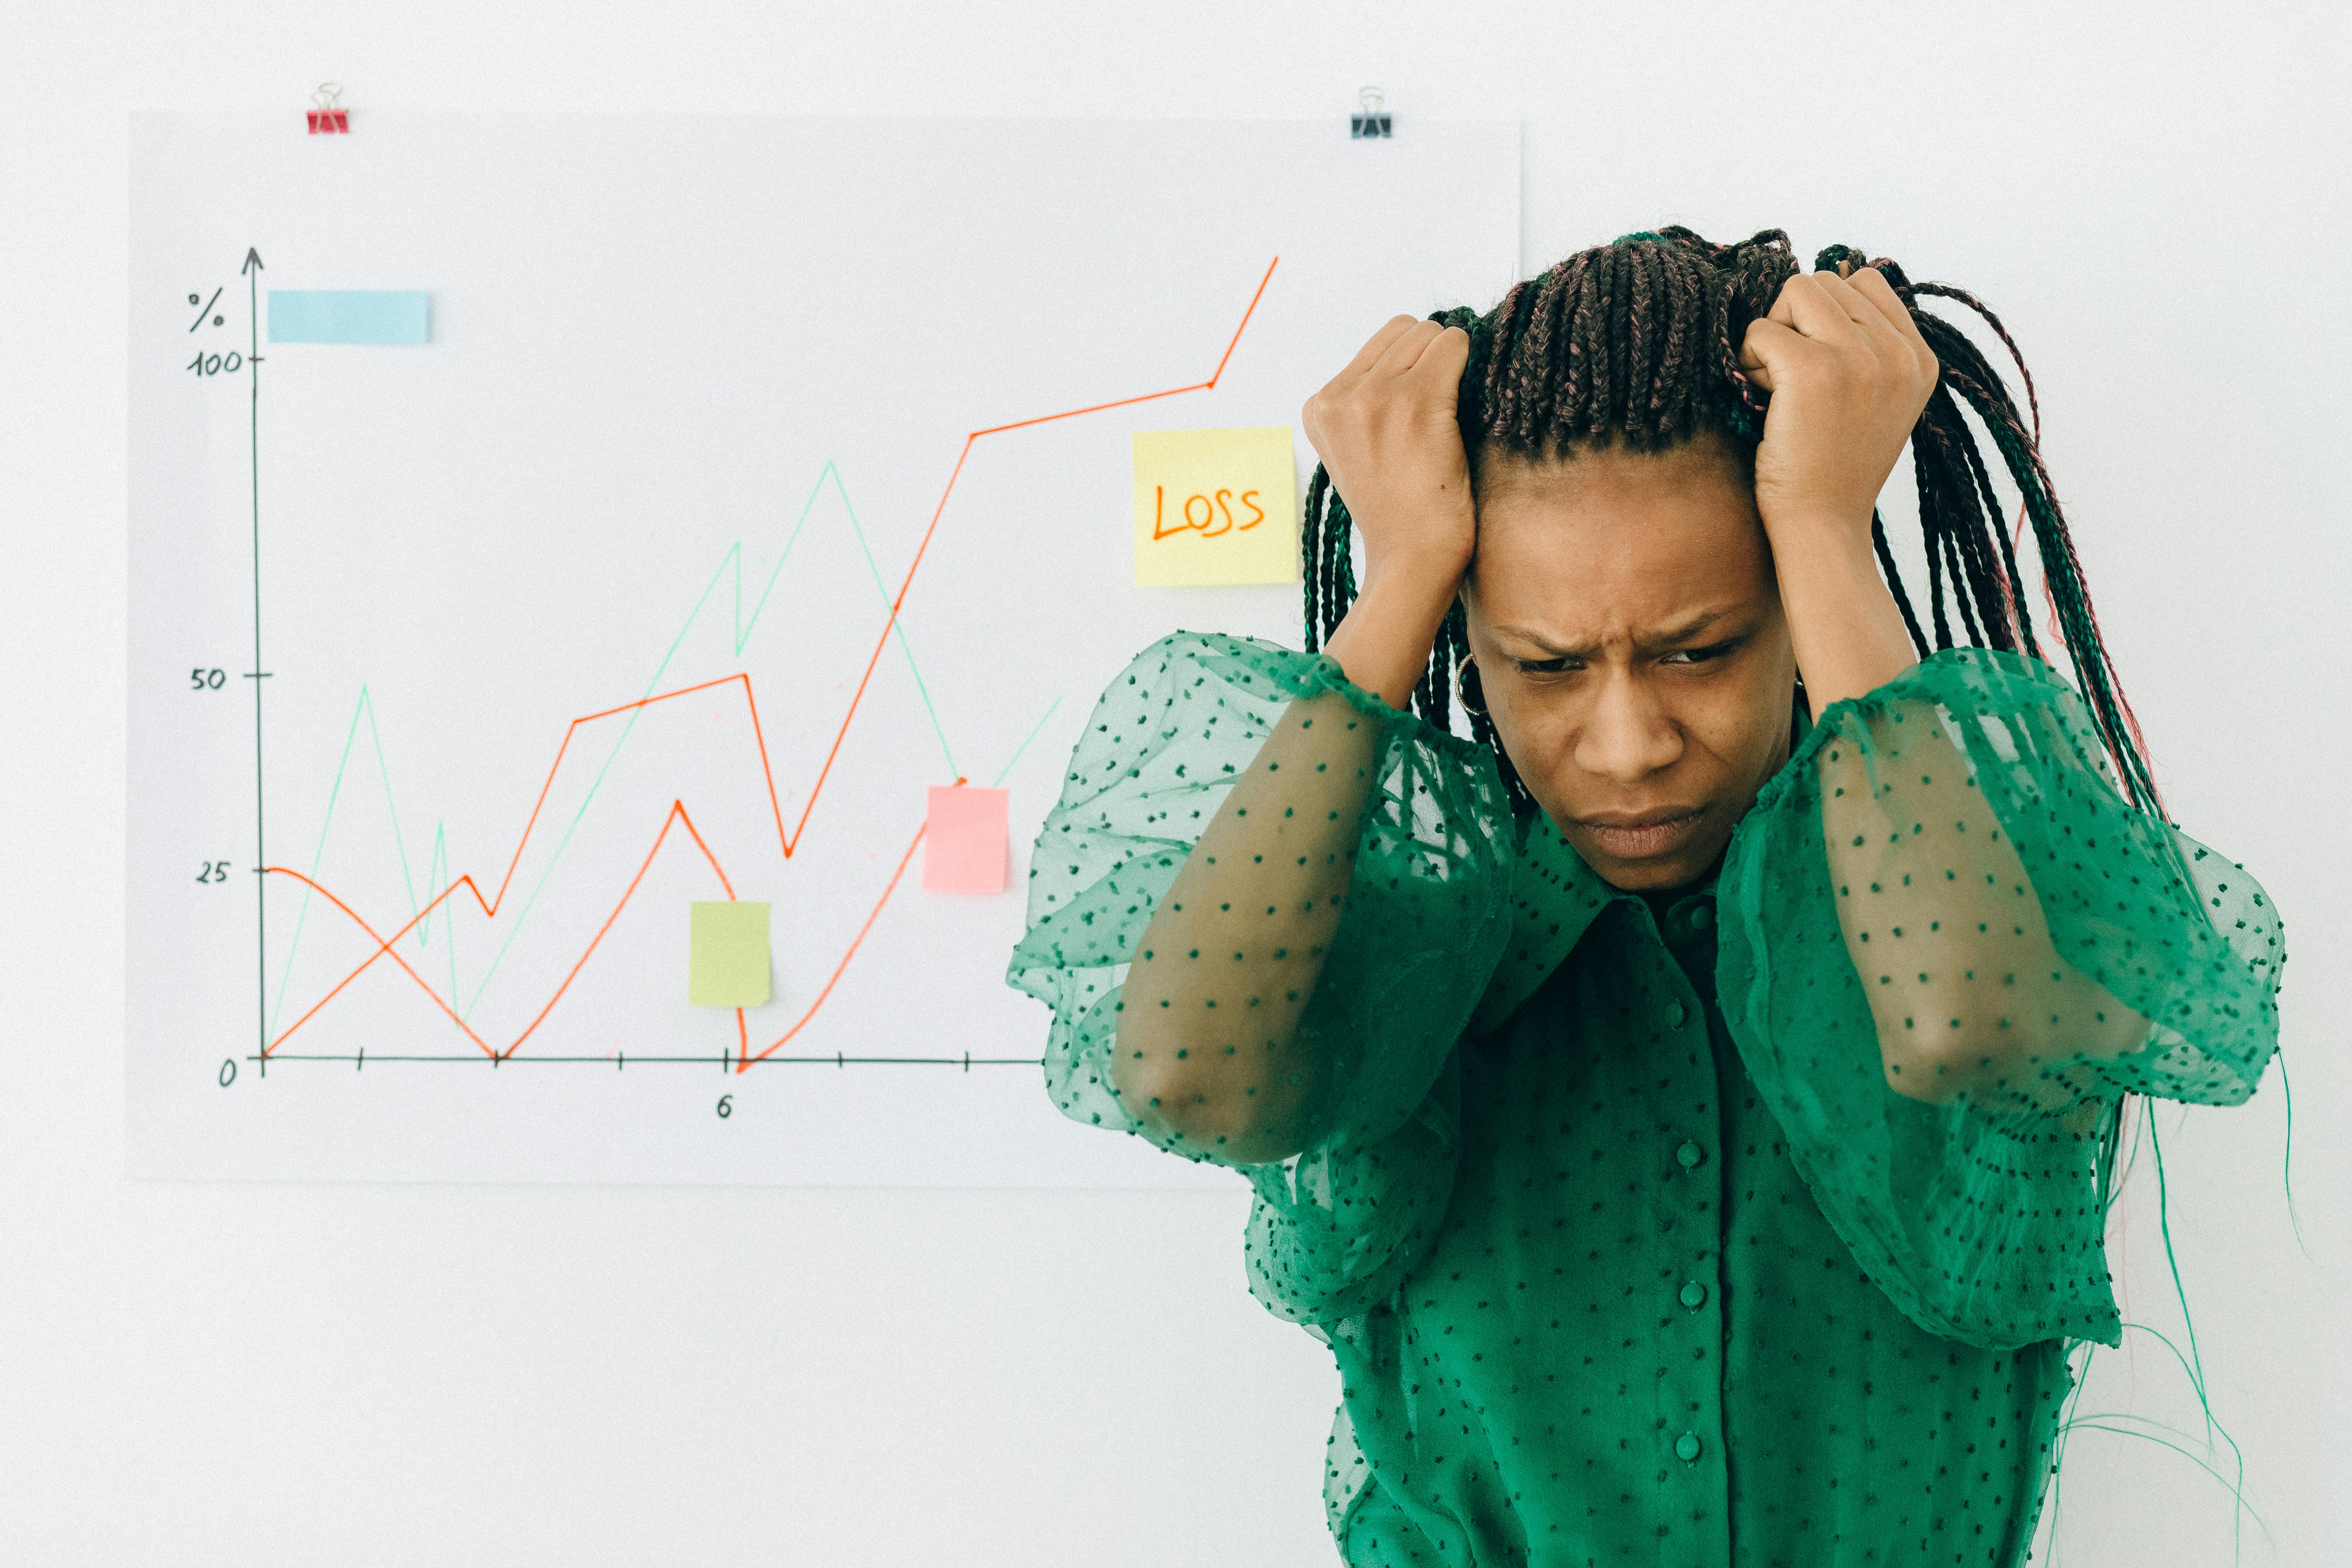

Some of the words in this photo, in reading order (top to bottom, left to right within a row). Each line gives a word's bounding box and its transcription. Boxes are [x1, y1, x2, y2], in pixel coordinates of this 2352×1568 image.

[188, 286, 225, 333] %
[186, 351, 242, 377] 100
[1152, 485, 1265, 541] LOSS
[191, 668, 226, 690] 50
[195, 861, 231, 884] 25
[219, 1058, 237, 1088] 0
[716, 1094, 734, 1119] 6
